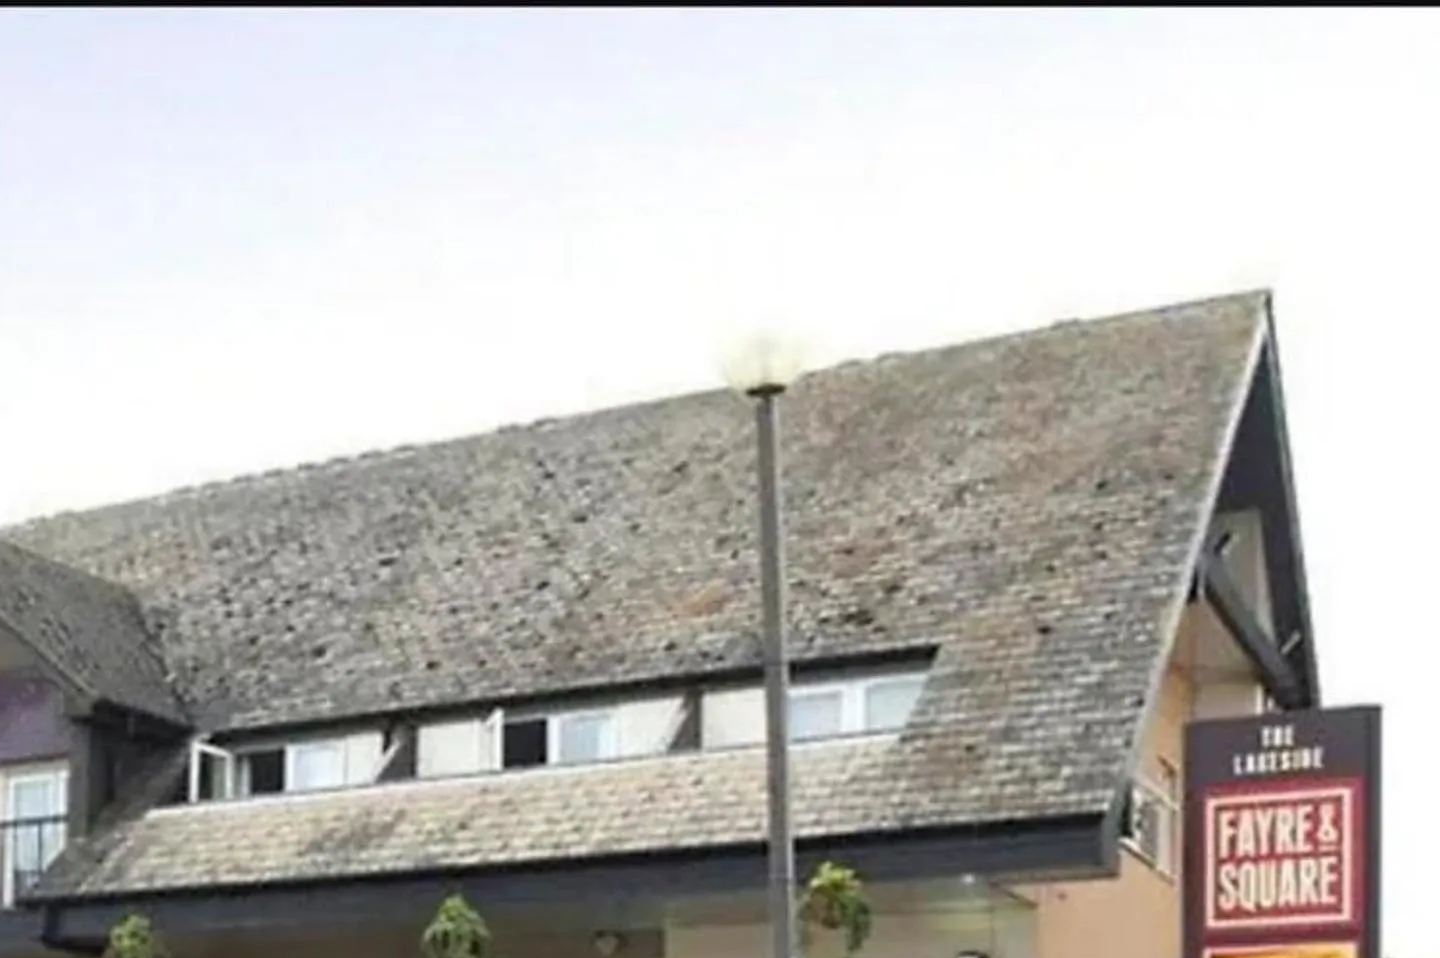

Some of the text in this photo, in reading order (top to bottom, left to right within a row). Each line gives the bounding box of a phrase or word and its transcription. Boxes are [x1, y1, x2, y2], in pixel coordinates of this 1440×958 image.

[1261, 724, 1295, 746] THE
[1217, 804, 1314, 859] FAYRE
[1217, 856, 1339, 912] SQUARE
